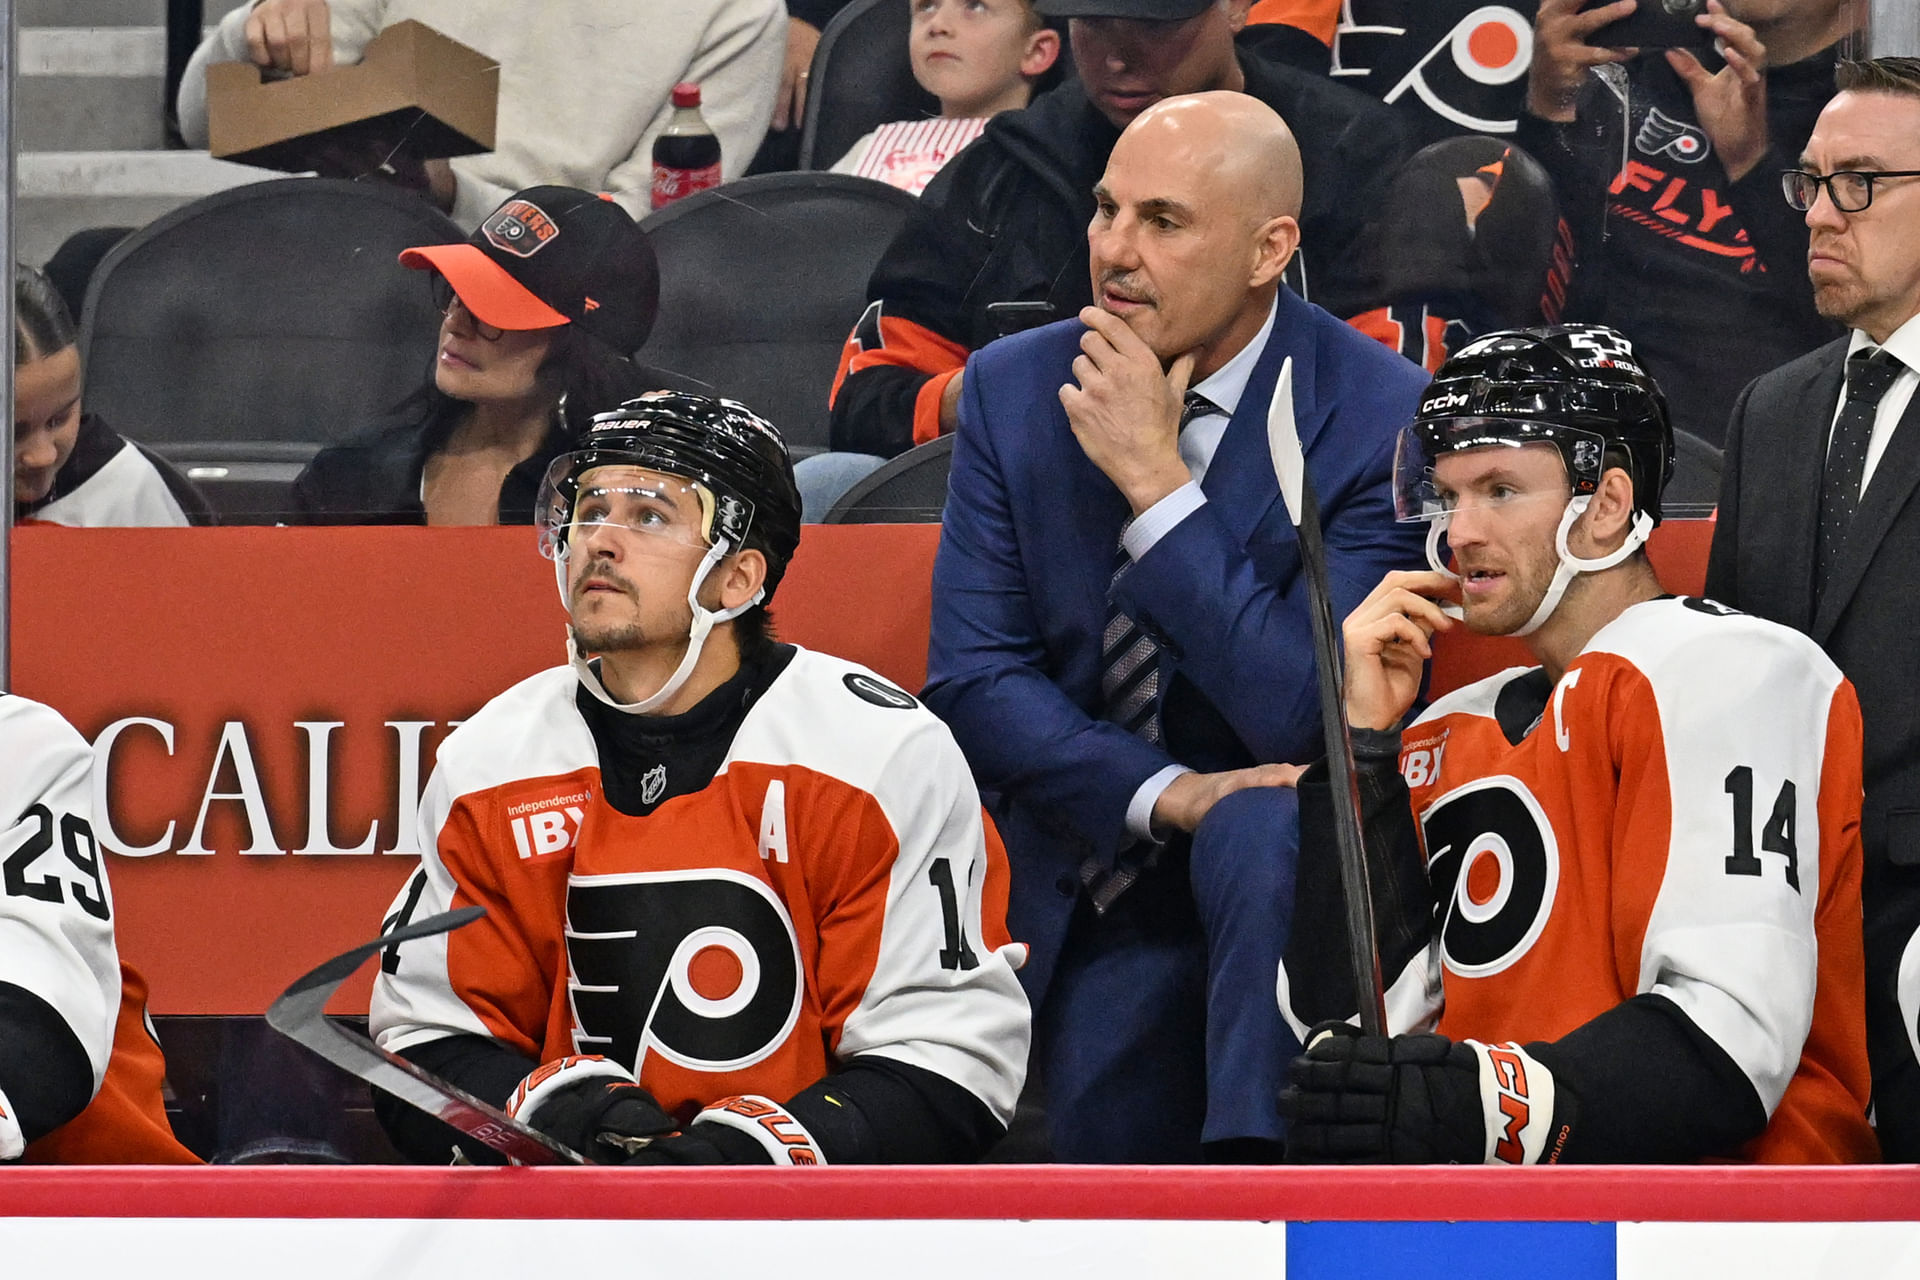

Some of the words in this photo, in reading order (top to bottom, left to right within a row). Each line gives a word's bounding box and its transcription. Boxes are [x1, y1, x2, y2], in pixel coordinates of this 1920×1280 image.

[1609, 160, 1749, 241] FLY
[591, 420, 651, 432] BAUER
[1422, 393, 1469, 413] CCM
[1553, 667, 1582, 752] C
[93, 716, 463, 857] CALI
[507, 792, 585, 816] Independence
[758, 779, 788, 863] A
[3, 803, 110, 921] 29
[1724, 765, 1801, 896] 14
[1488, 1043, 1530, 1165] CM
